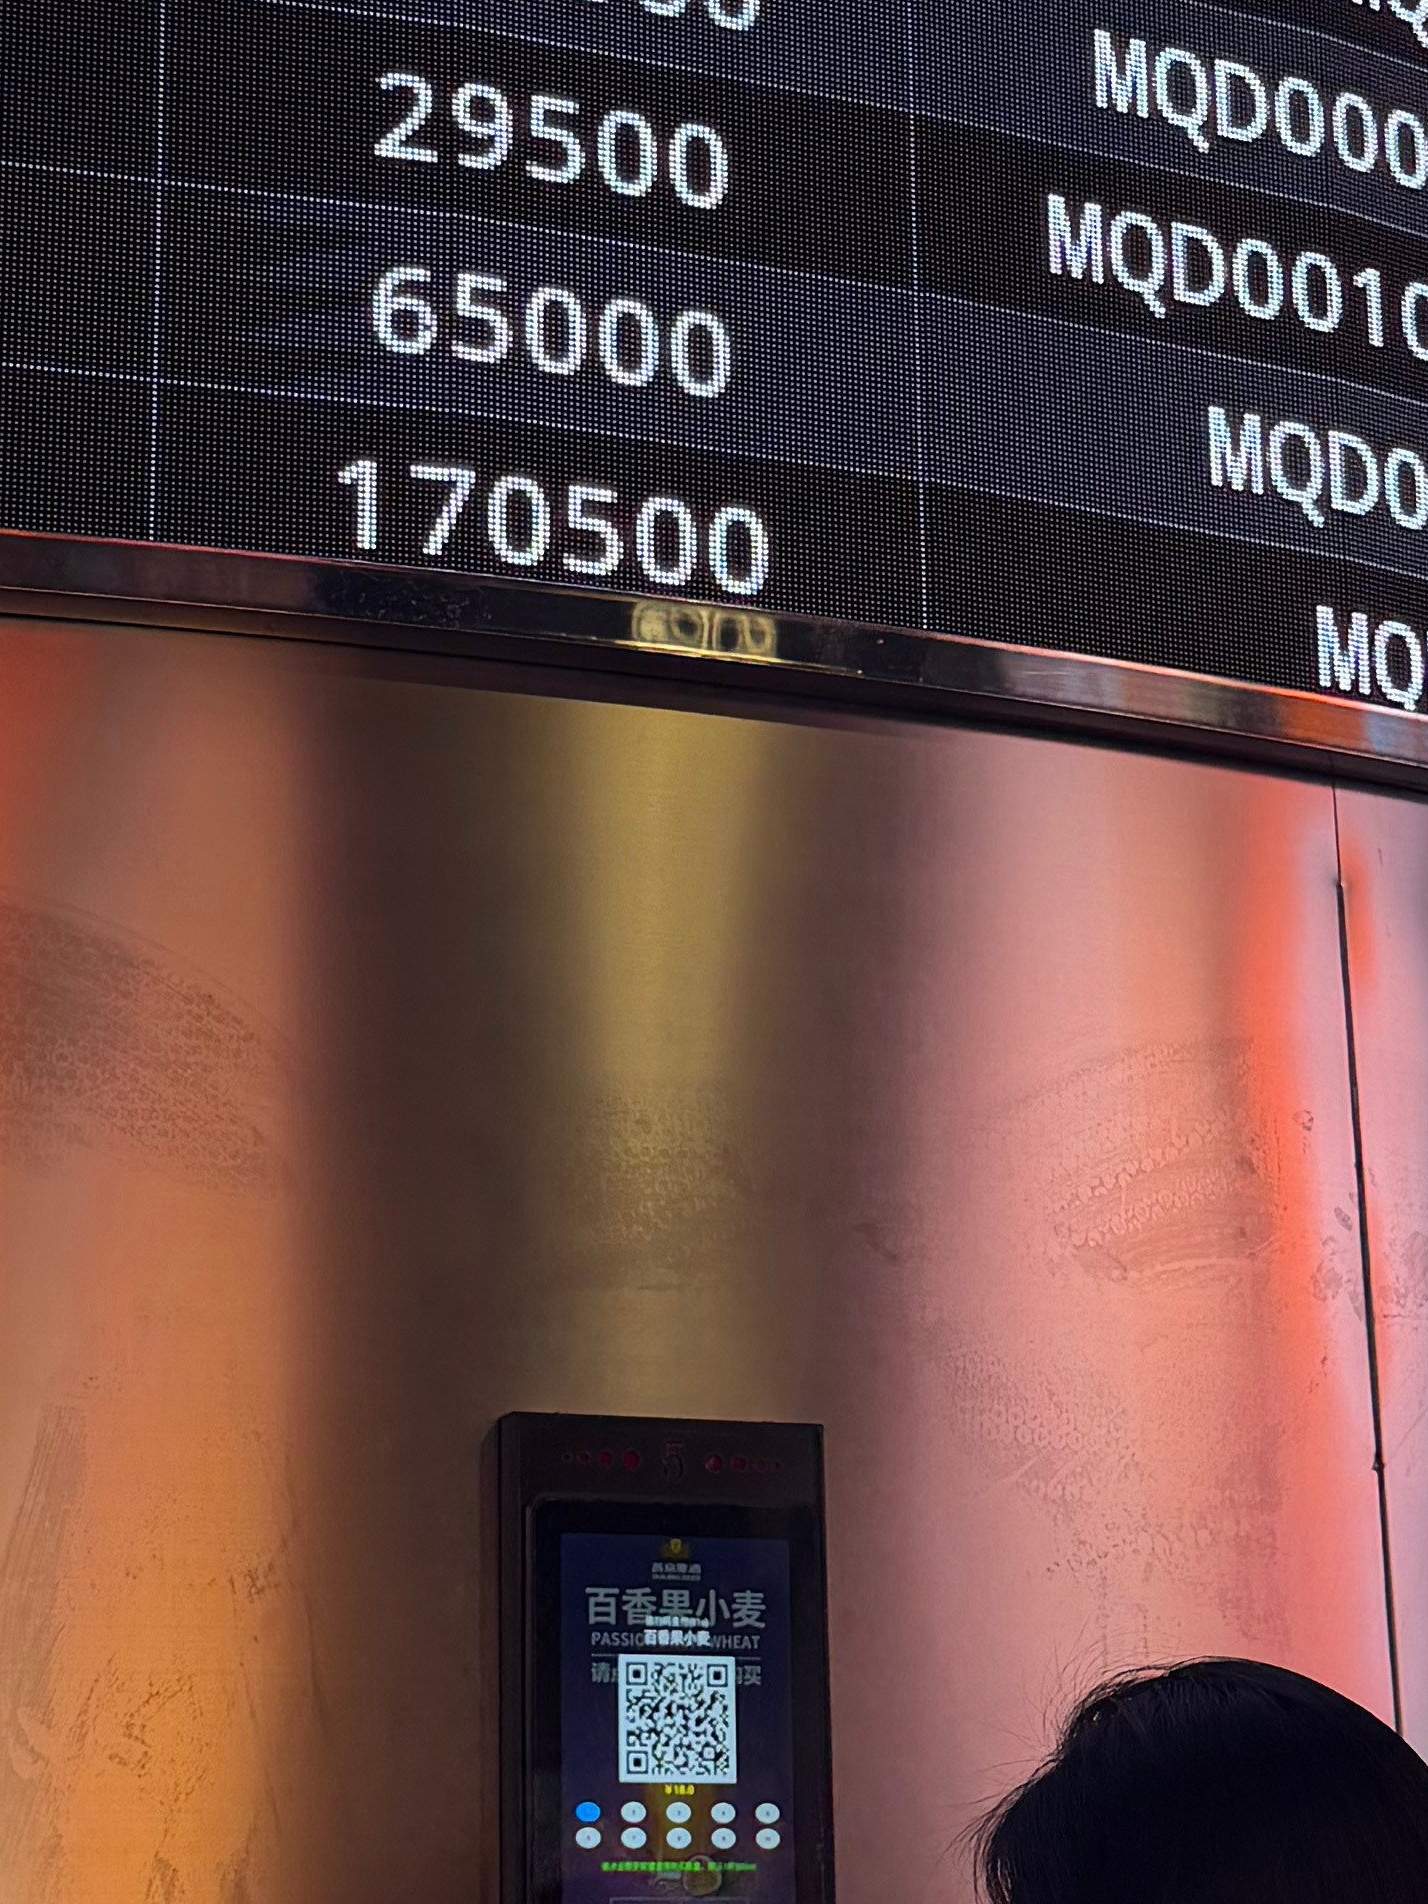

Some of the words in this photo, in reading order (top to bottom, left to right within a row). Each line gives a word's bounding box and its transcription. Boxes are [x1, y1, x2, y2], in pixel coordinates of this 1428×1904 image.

[374, 72, 728, 209] 29500
[372, 266, 731, 397] 65000
[338, 459, 768, 595] 170500
[585, 1586, 767, 1629] 百香果小麦
